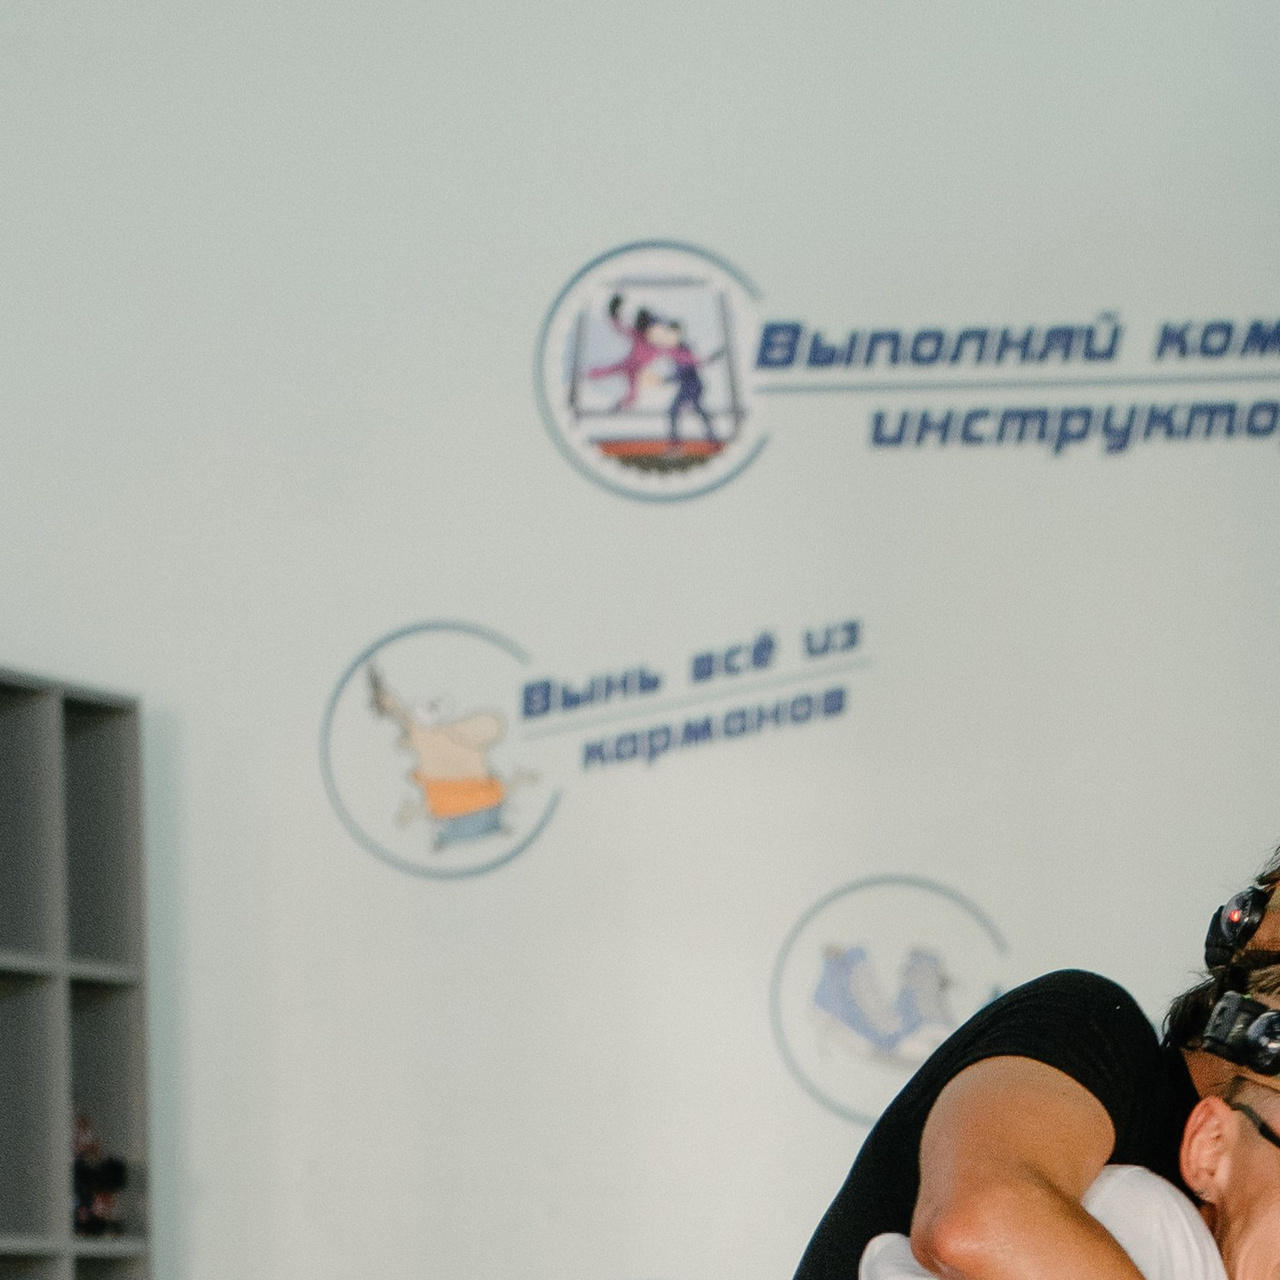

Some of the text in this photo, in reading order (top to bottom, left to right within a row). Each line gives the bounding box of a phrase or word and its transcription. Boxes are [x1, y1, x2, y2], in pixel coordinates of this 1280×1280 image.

[754, 310, 1123, 369] Выполняй
[521, 620, 863, 719] Вынь всё из
[583, 686, 847, 771] карманов
